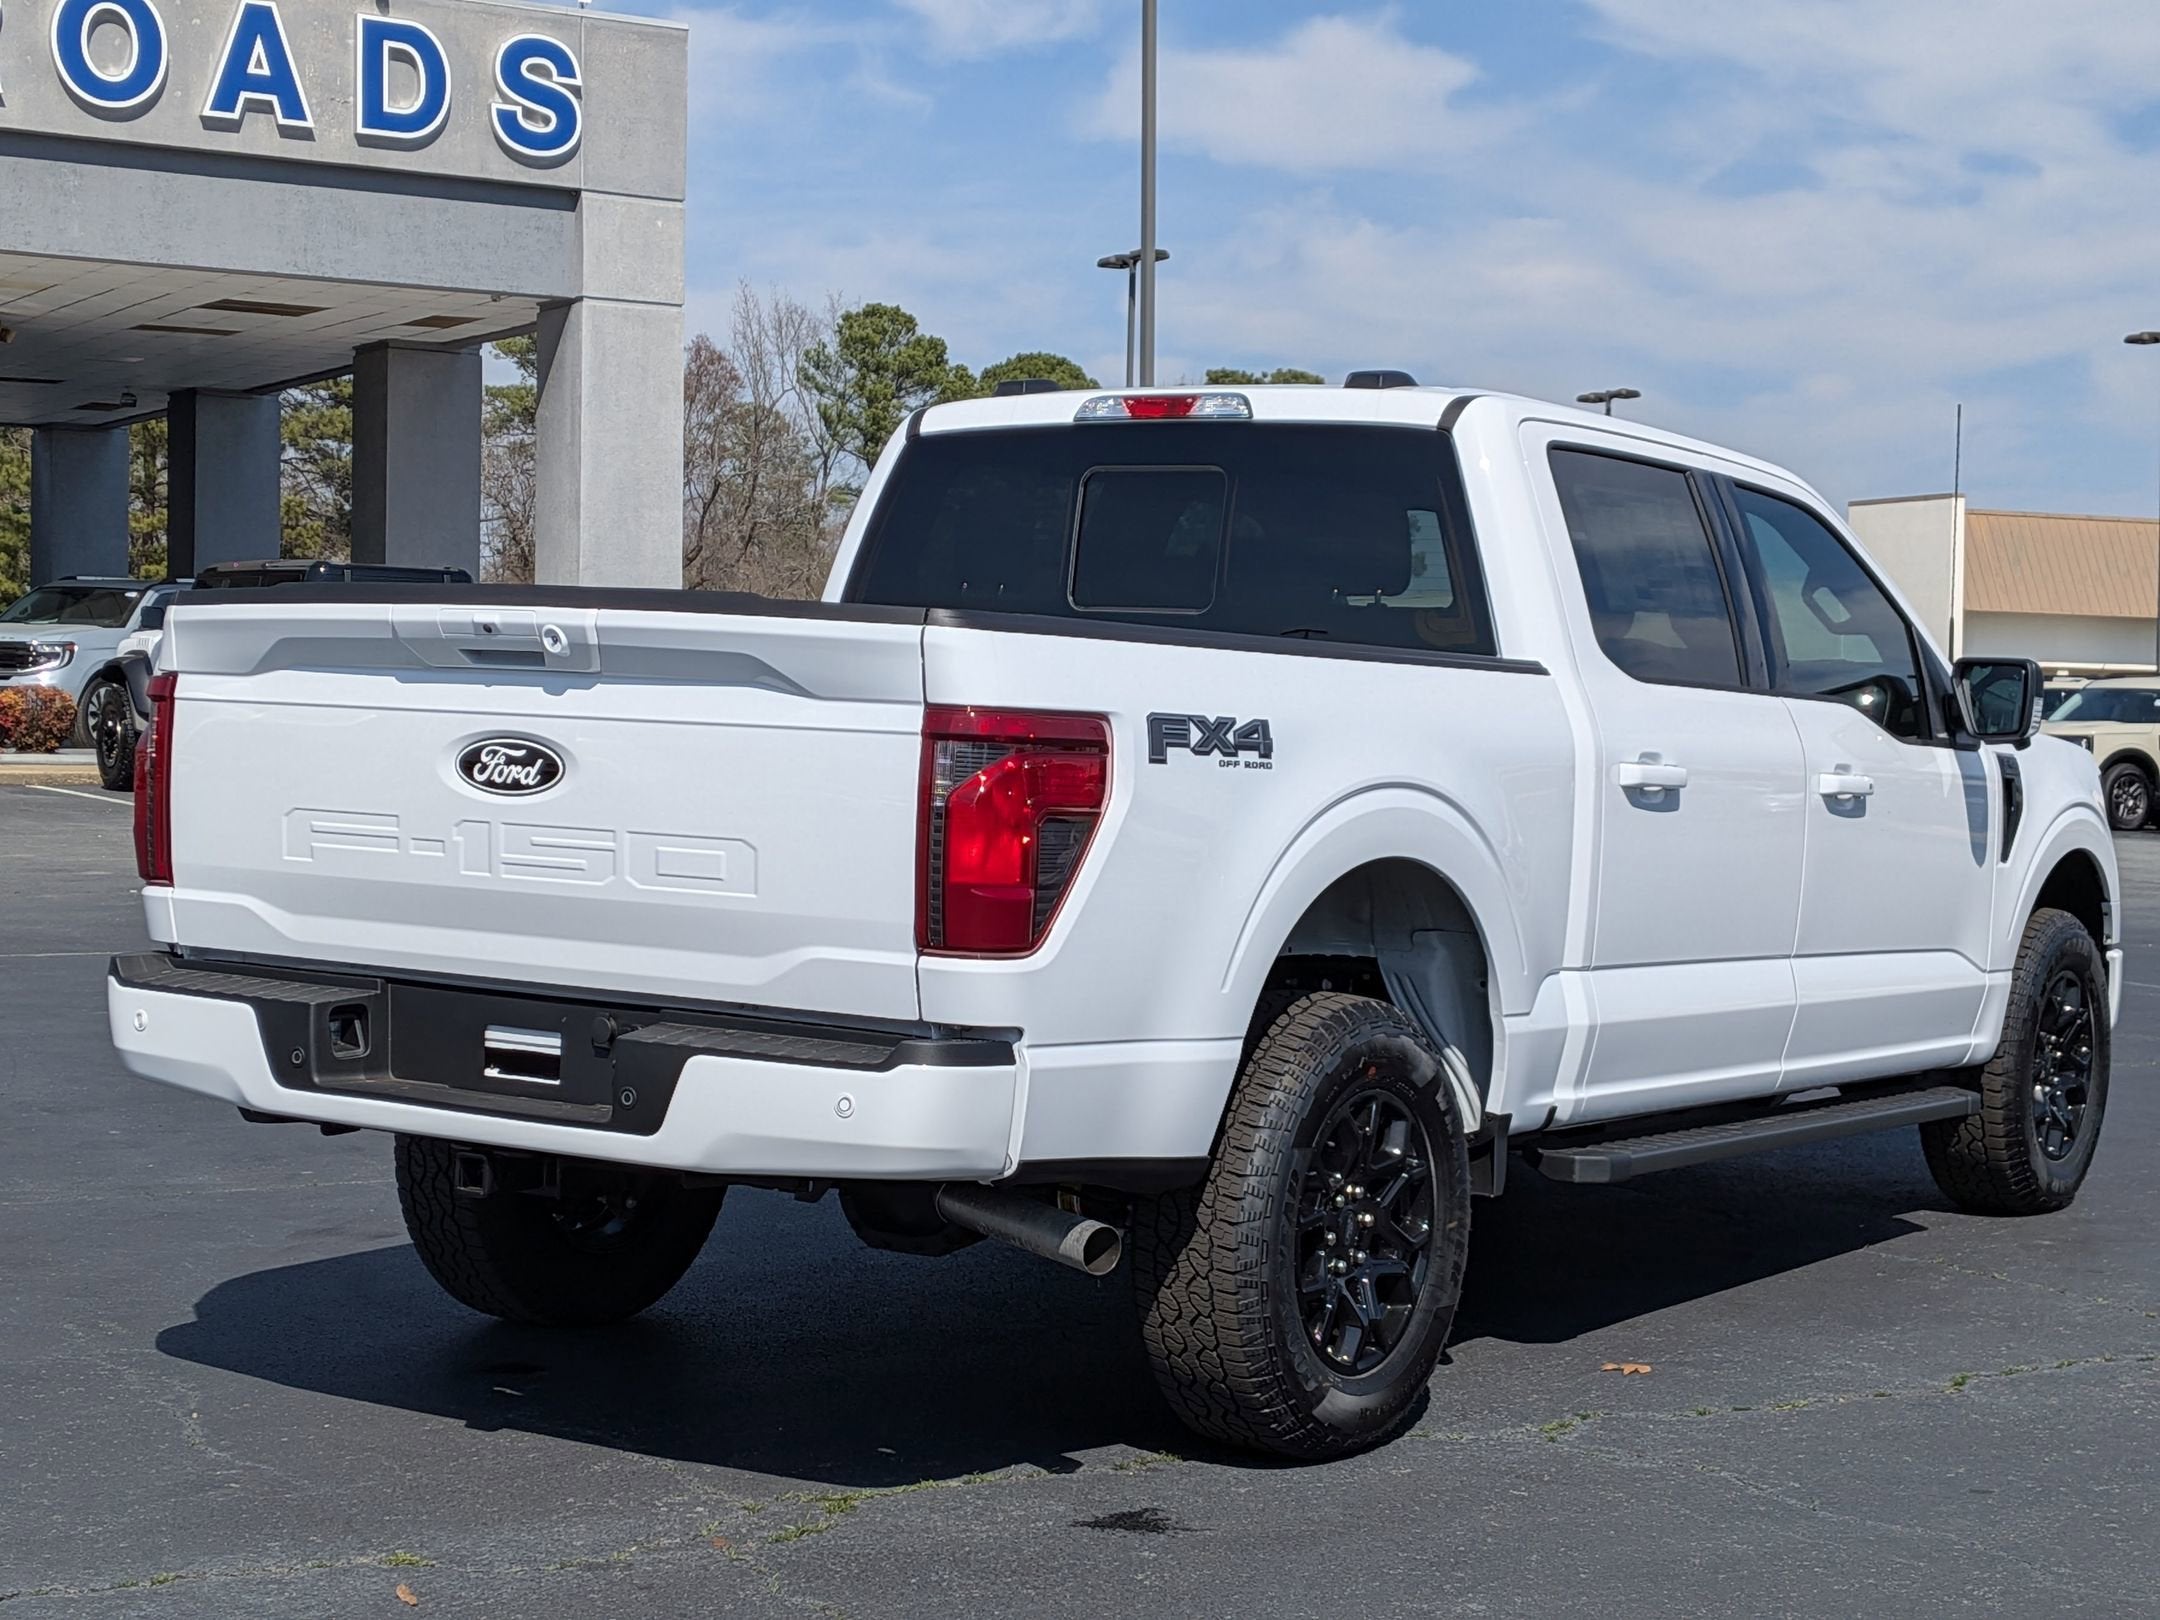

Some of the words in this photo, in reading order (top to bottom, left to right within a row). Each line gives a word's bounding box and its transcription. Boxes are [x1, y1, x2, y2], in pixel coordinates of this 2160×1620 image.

[0, 0, 583, 158] OADS
[1146, 711, 1274, 765] FX4
[1218, 759, 1241, 769] OFF
[1244, 760, 1273, 770] ROAD
[472, 745, 544, 786] Ford
[282, 806, 758, 898] F-150
